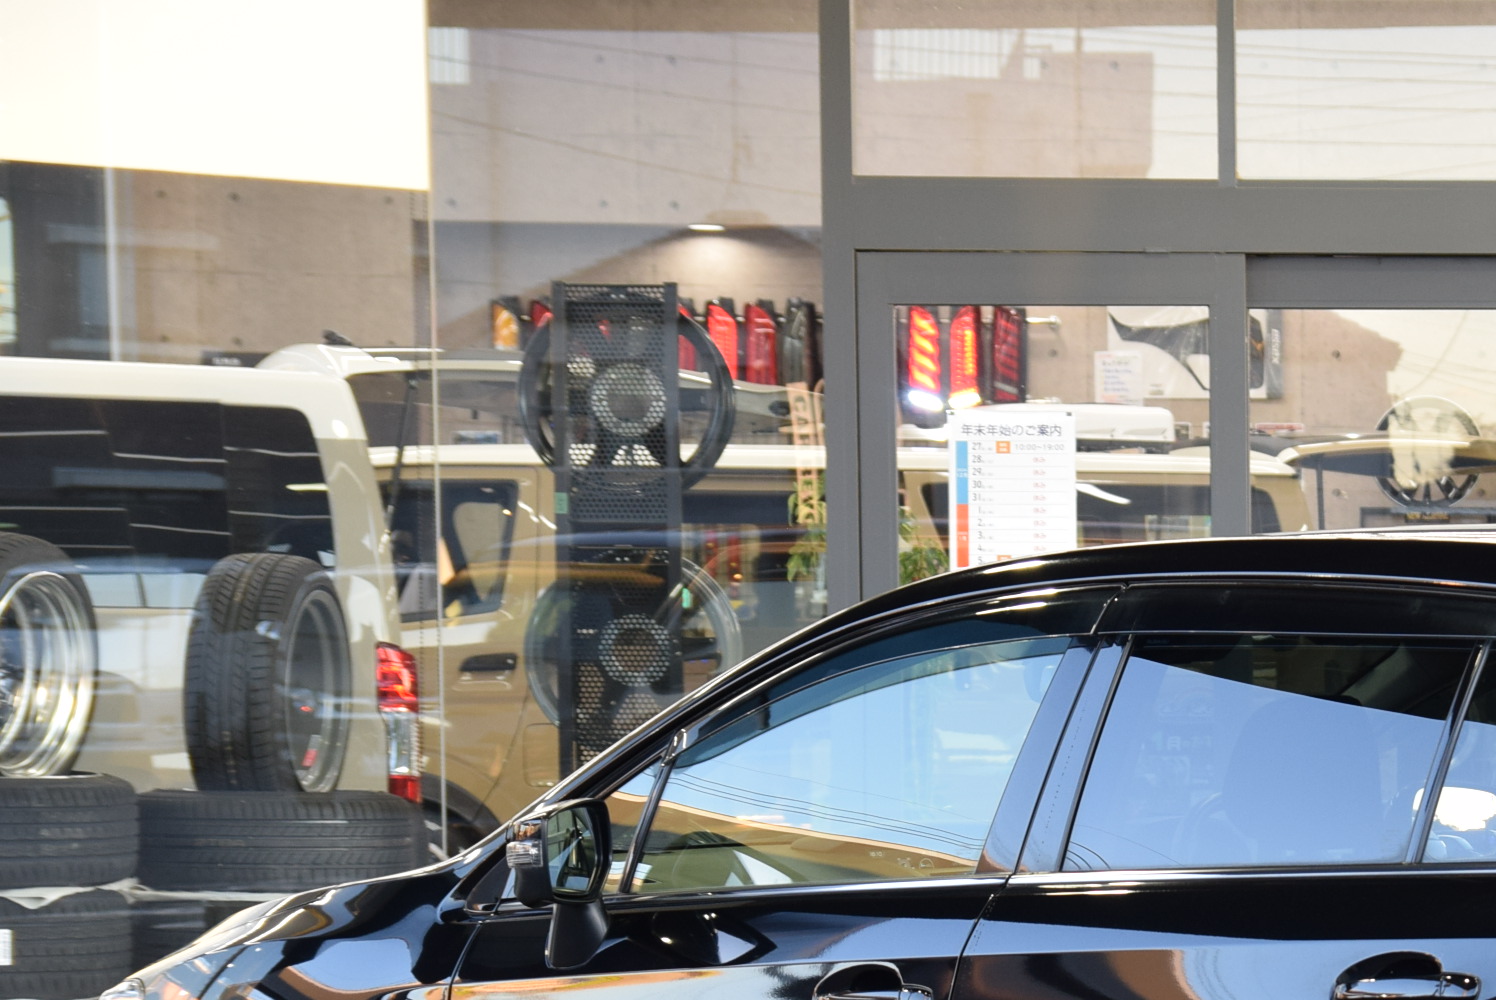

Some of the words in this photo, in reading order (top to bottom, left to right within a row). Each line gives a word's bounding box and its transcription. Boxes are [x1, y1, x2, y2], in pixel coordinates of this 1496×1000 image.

[961, 424, 1063, 436] 年末年始のご案内
[972, 442, 981, 451] 27
[972, 455, 981, 463] 28
[972, 467, 981, 476] 29
[972, 480, 981, 488] 30
[972, 493, 981, 501] 31
